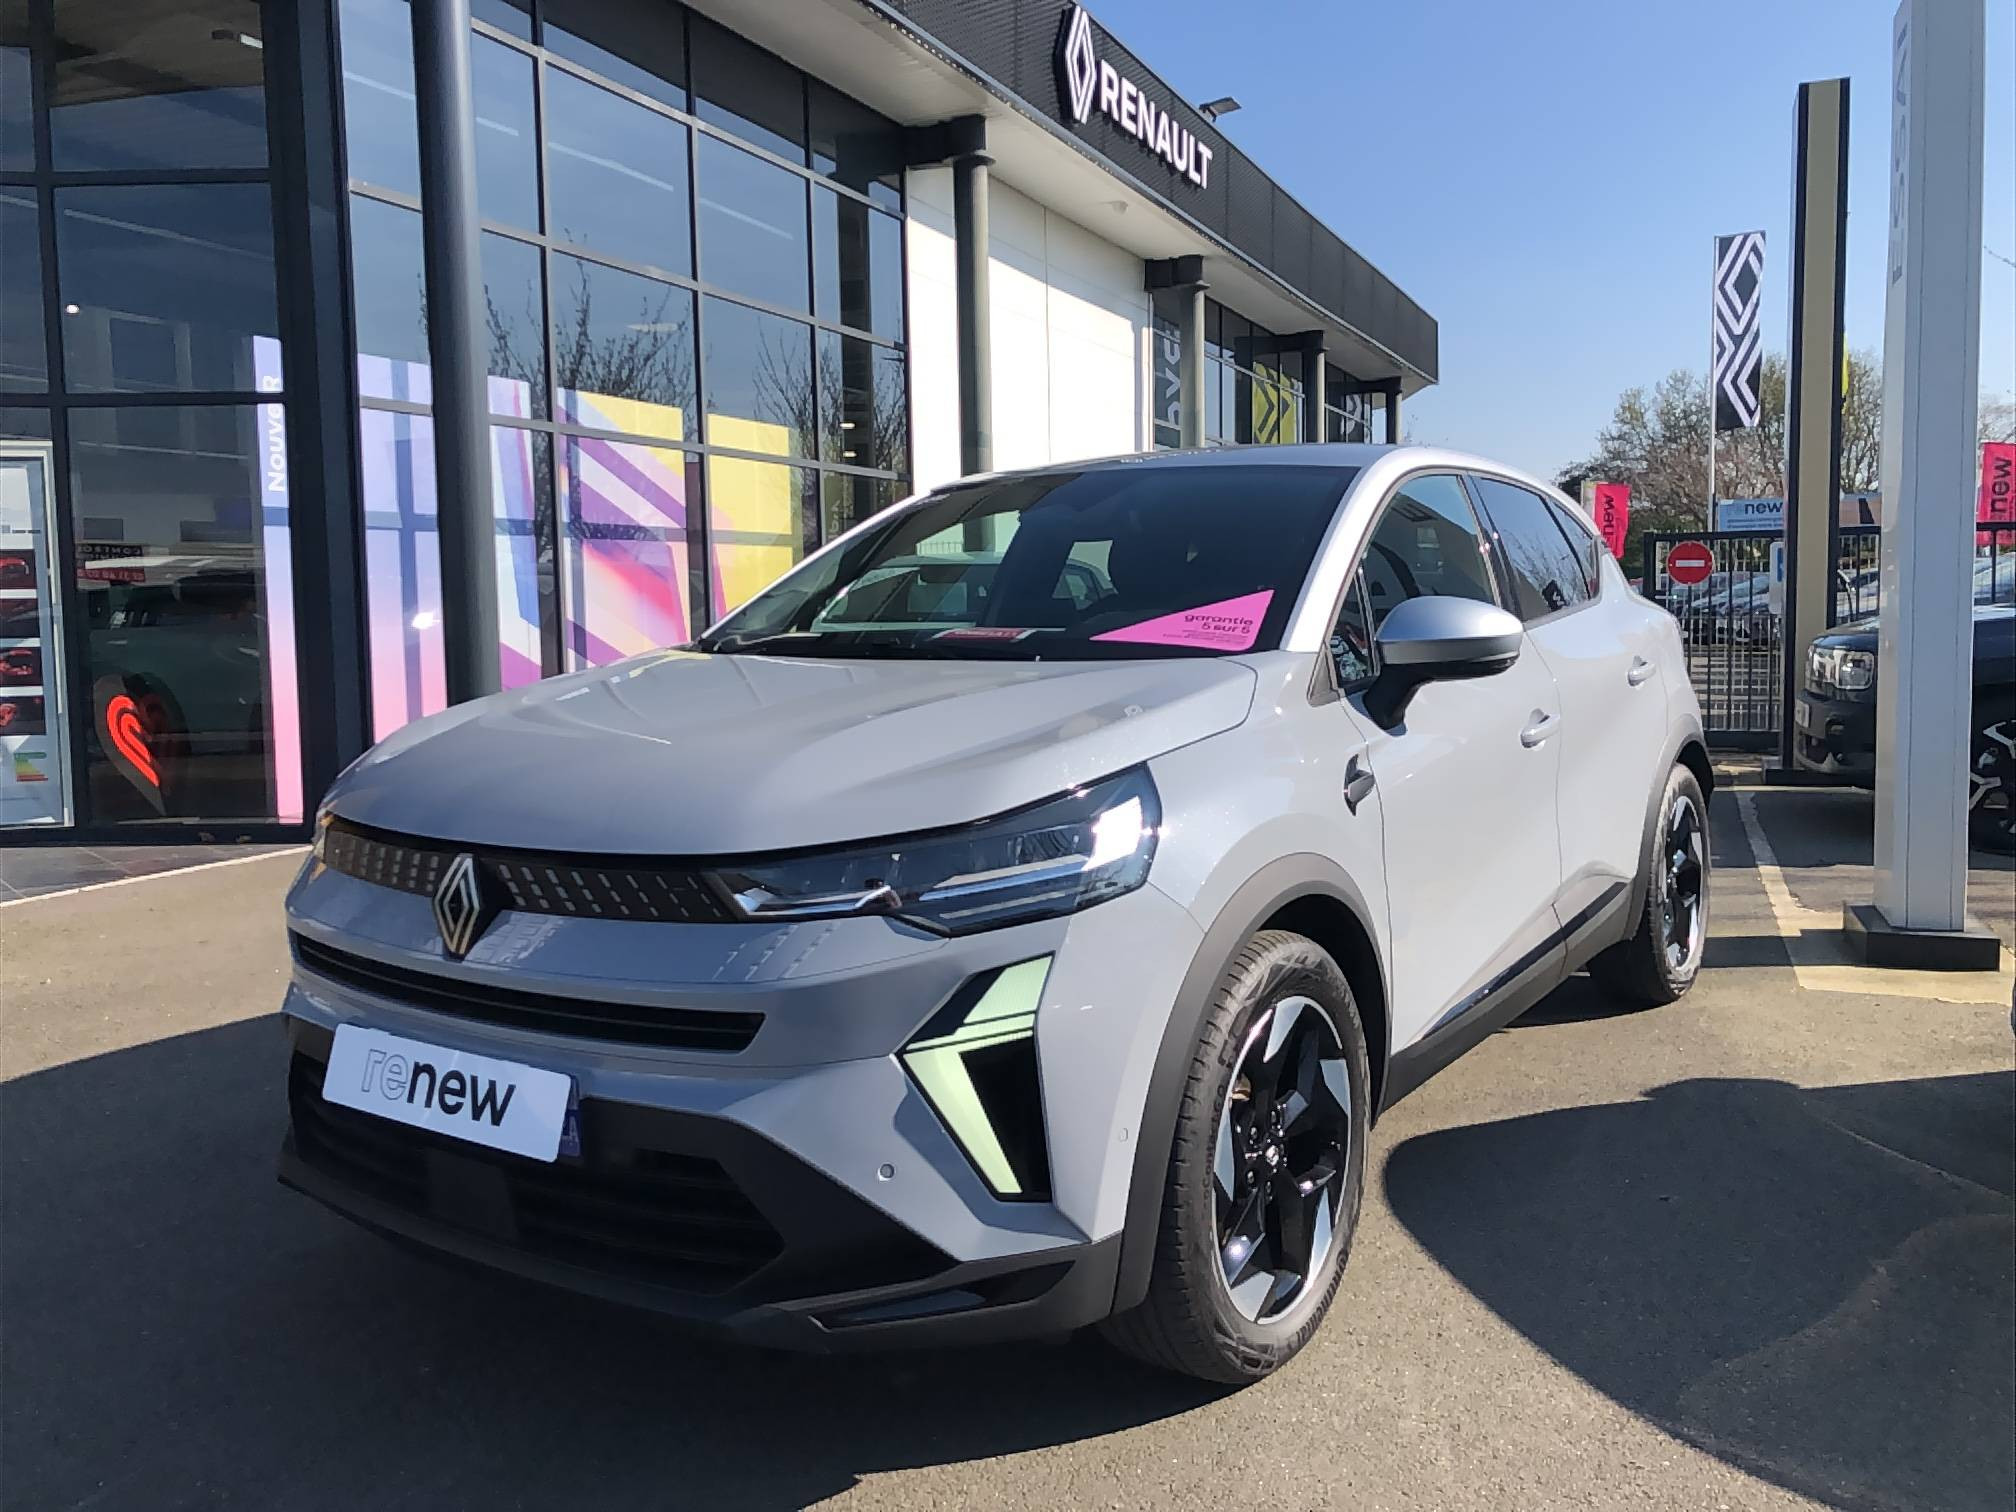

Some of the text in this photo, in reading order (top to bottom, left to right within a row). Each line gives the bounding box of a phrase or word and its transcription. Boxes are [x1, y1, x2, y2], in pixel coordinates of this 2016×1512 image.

[1100, 58, 1213, 190] RENAULT
[1184, 615, 1254, 626] garantie
[1201, 622, 1251, 635] 5 sur 5
[361, 1048, 516, 1127] renew
